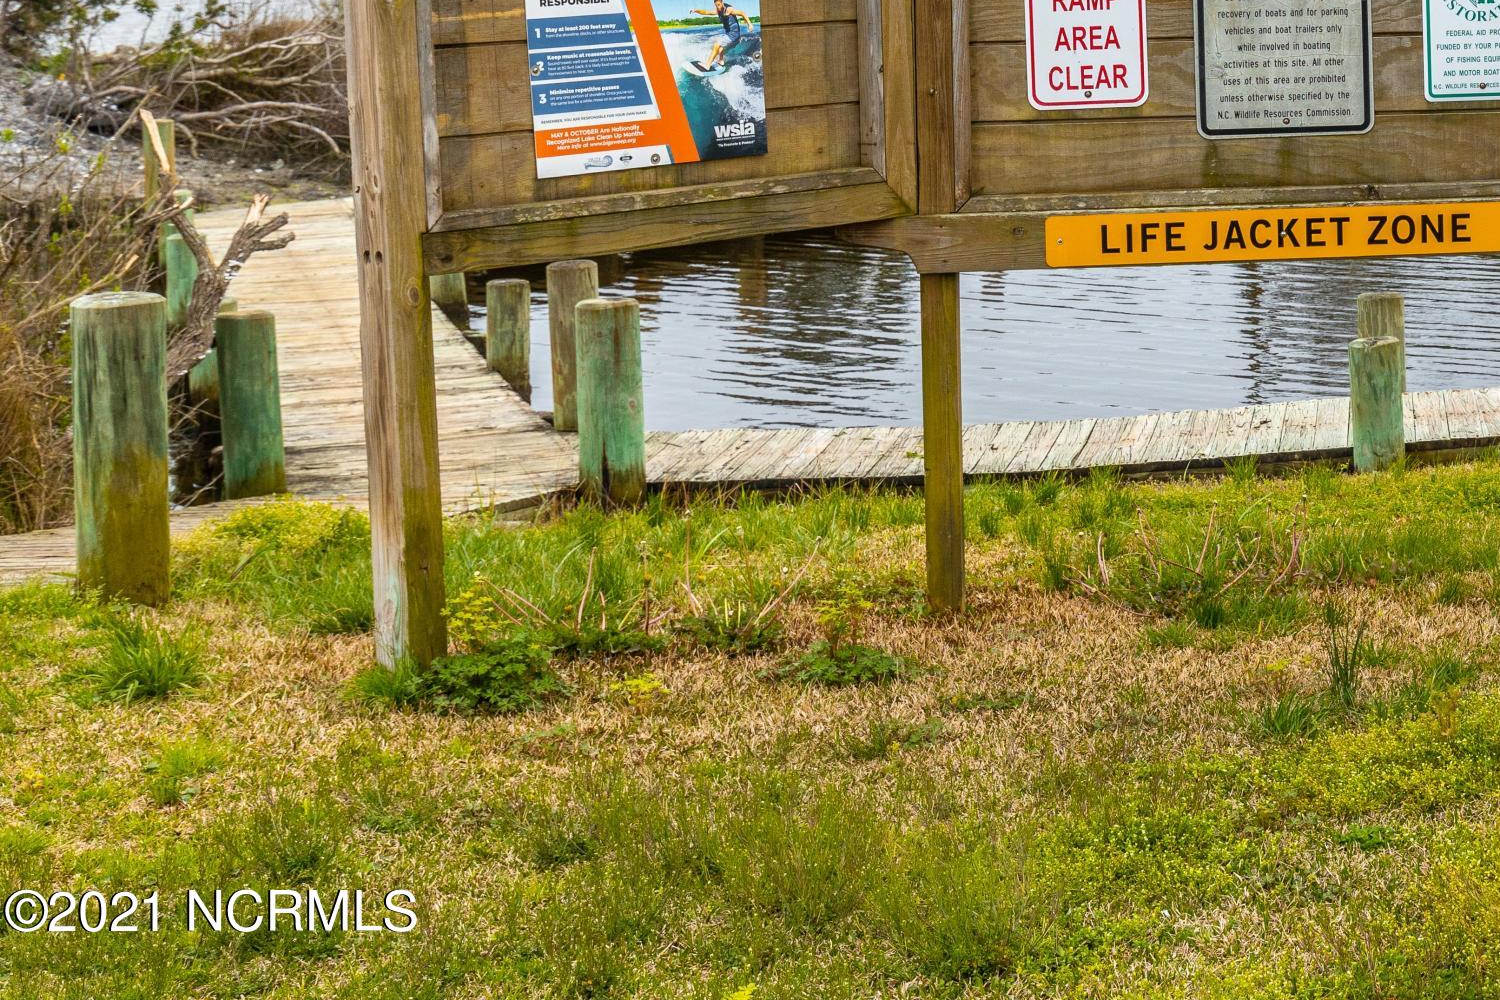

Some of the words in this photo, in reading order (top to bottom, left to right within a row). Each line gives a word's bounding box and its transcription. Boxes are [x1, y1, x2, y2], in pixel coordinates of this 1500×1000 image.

[1218, 9, 1250, 20] recovery
[1255, 9, 1262, 18] of
[1266, 8, 1286, 17] boats
[1290, 8, 1303, 17] and
[1307, 8, 1317, 16] for
[1321, 7, 1348, 18] parking
[535, 28, 541, 38] 1
[1225, 26, 1255, 35] vehicles
[1259, 26, 1271, 34] and
[1275, 25, 1291, 34] boat
[1296, 25, 1323, 33] trailers
[1327, 25, 1342, 35] only
[1055, 26, 1120, 51] AREA
[1238, 42, 1256, 52] while
[1259, 42, 1289, 51] involved
[1293, 42, 1299, 50] in
[1303, 41, 1330, 53] boating
[536, 61, 544, 71] 2
[1224, 59, 1258, 69] activities
[1263, 60, 1270, 68] at
[1274, 59, 1288, 67] this
[1292, 59, 1308, 67] site.
[1312, 58, 1321, 66] All
[1325, 57, 1344, 66] other
[1049, 65, 1128, 91] CLEAR
[1223, 77, 1241, 86] uses
[1245, 76, 1252, 85] of
[1256, 76, 1269, 85] this
[1273, 76, 1290, 84] area
[1309, 75, 1346, 85] prohibited
[550, 88, 574, 96] Minimize
[575, 86, 601, 94] repetitive
[602, 84, 619, 92] passes
[539, 94, 546, 104] 3
[1220, 93, 1244, 102] unless
[1248, 93, 1284, 102] otherwise
[1289, 92, 1322, 103] specified
[1325, 92, 1334, 102] by
[1338, 91, 1349, 99] the
[1218, 110, 1232, 120] N.C.
[1234, 110, 1260, 119] Wildlife
[1264, 109, 1302, 119] Resources
[1306, 108, 1354, 117] Commission.
[714, 120, 755, 138] wsia
[546, 138, 580, 146] Recognized
[1100, 222, 1186, 254] LIFE
[1203, 217, 1351, 250] JACKET
[1367, 213, 1471, 244] ZONE
